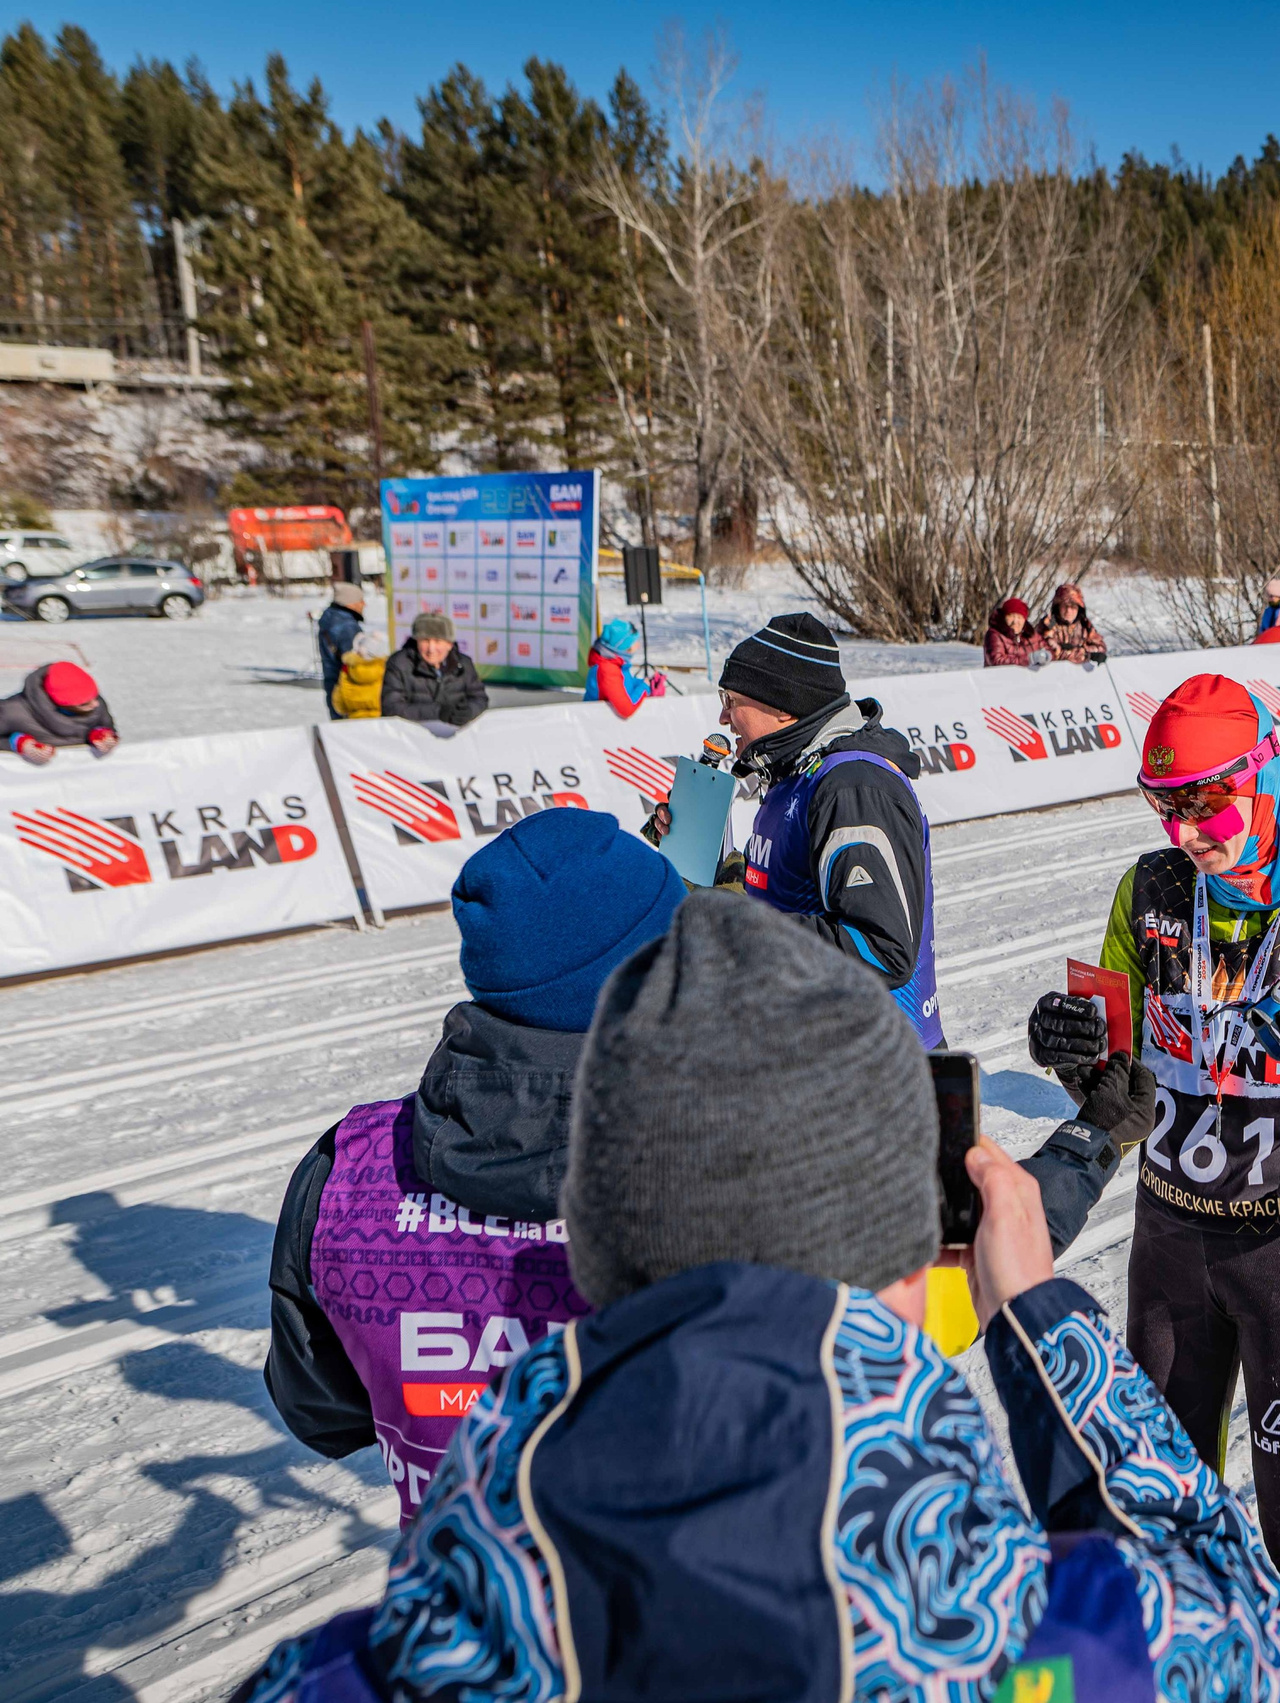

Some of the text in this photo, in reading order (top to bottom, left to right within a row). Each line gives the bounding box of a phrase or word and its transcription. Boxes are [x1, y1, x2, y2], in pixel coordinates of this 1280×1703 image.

[907, 721, 968, 746] RAS
[1041, 704, 1115, 729] KRAS
[913, 742, 976, 776] AND
[1048, 723, 1122, 757] LAND
[457, 765, 581, 800] KRAS
[150, 796, 308, 838] KRAS
[160, 824, 318, 880] LAND
[1147, 1087, 1275, 1186] 261
[1140, 1161, 1226, 1217] КОРОЛЕВСКИЕ
[400, 1312, 569, 1373] БА
